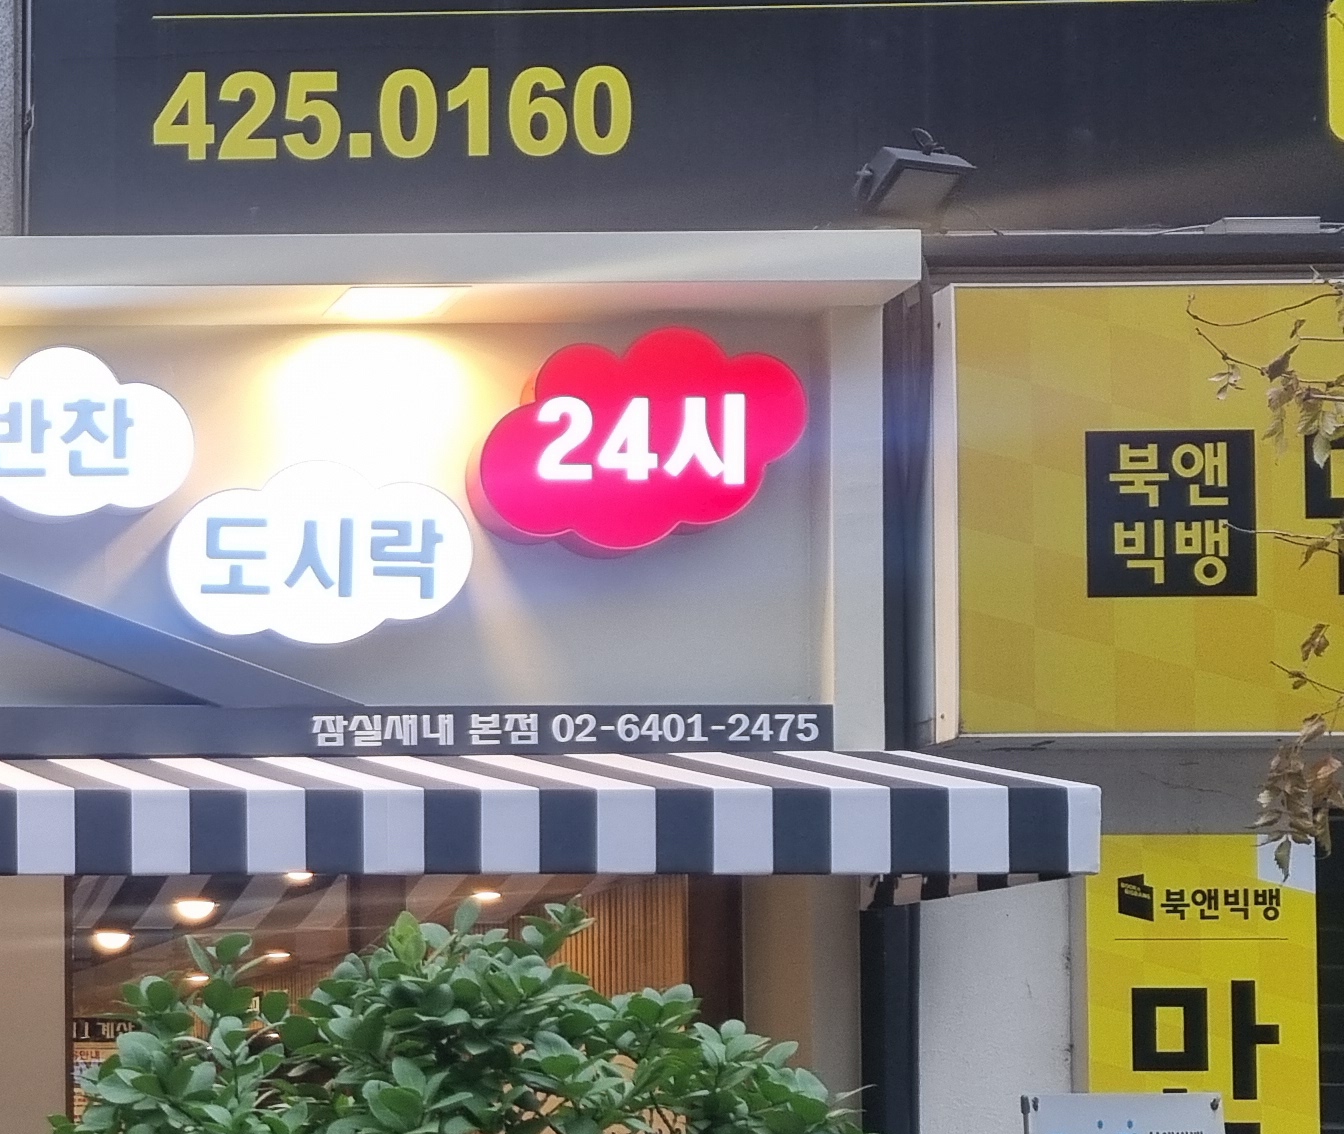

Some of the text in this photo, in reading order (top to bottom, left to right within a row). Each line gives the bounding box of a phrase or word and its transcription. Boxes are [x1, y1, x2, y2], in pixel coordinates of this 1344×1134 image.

[152, 65, 632, 160] 425.0160
[535, 392, 747, 486] 24시
[1109, 441, 1229, 508] 북앤
[198, 516, 444, 600] 도시락
[1114, 518, 1229, 586] 빅뱅
[311, 712, 820, 747] 잠실새내 본점 02-6401-2475
[1160, 888, 1281, 921] 북앤빅뱅
